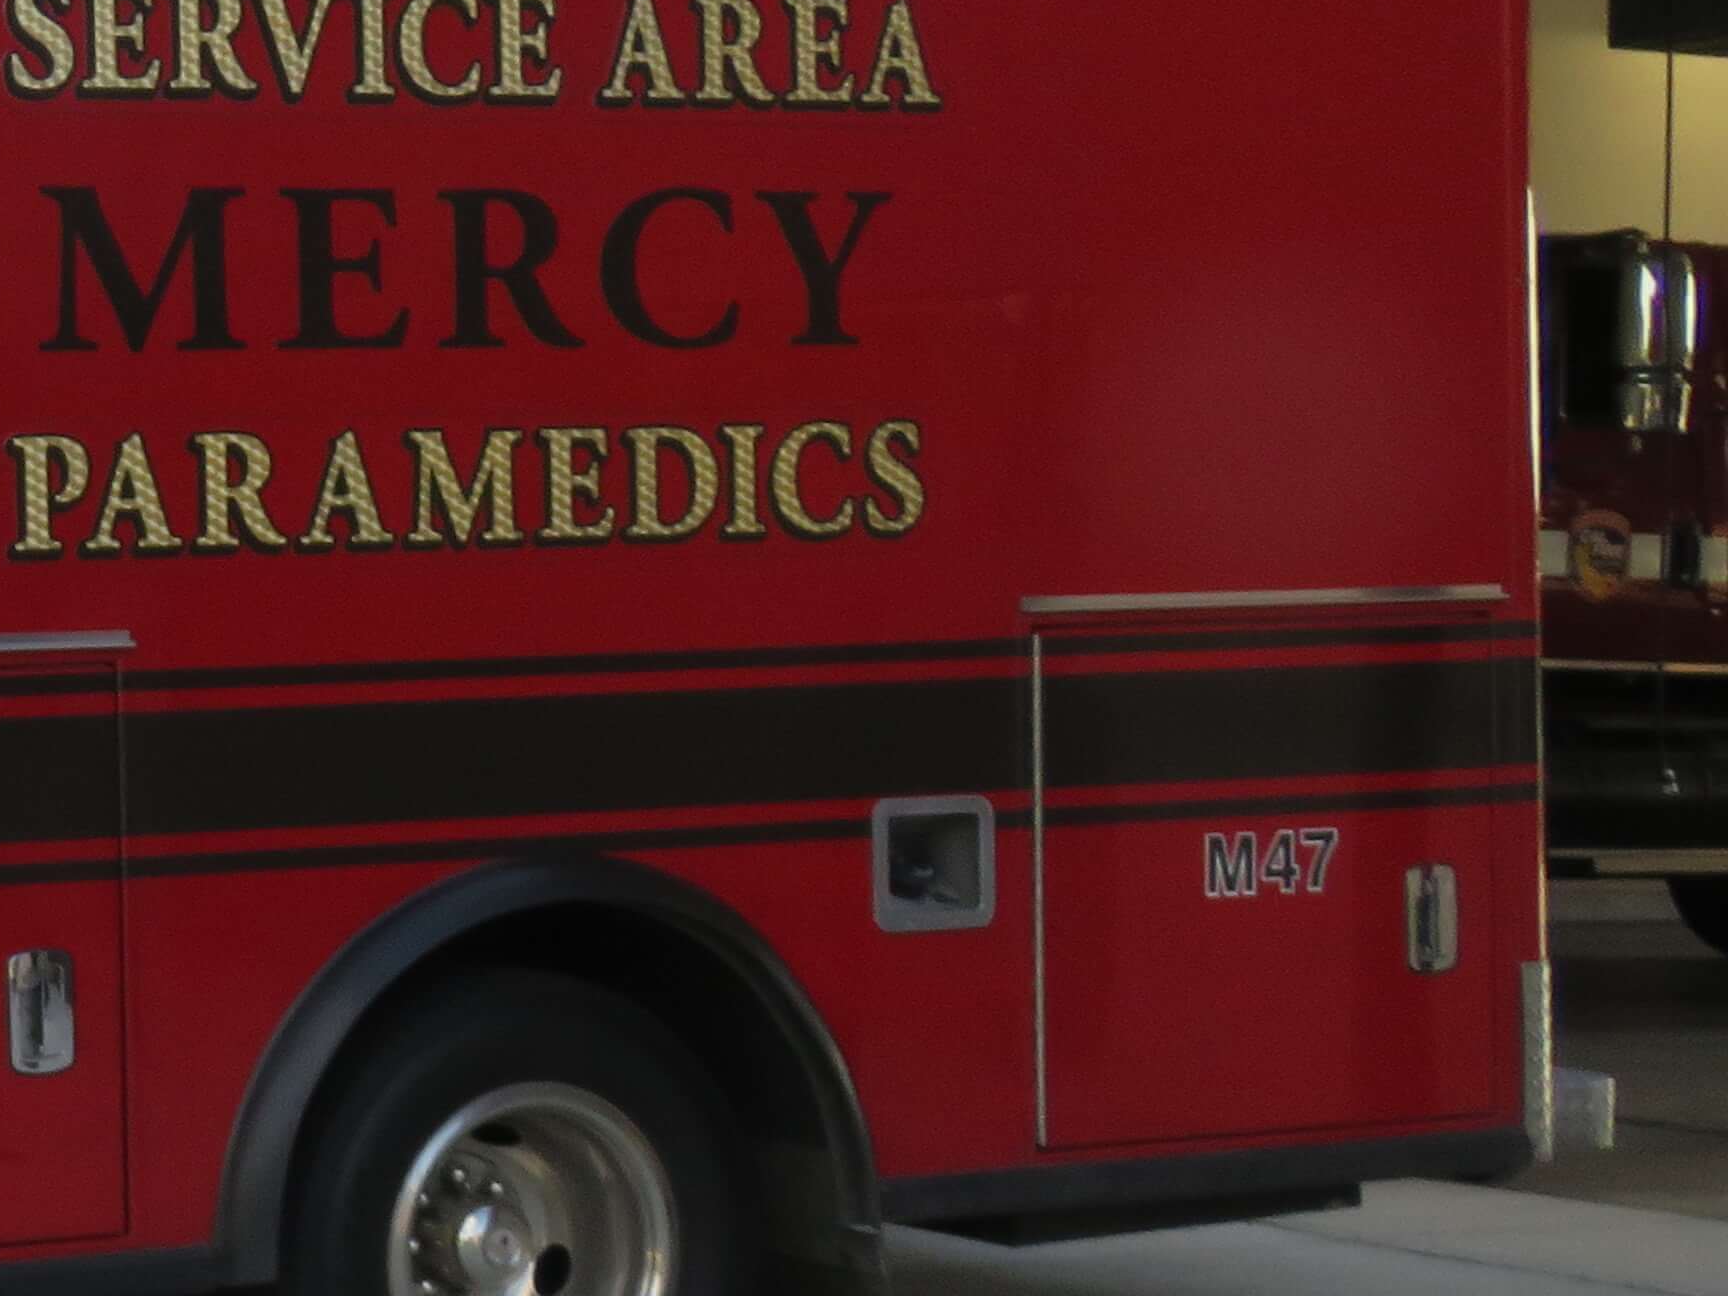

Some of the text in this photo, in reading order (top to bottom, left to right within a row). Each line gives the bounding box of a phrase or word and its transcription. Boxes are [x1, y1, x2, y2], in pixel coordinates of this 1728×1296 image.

[38, 185, 892, 352] MERCY
[8, 420, 925, 558] PARAMEDICS
[1204, 828, 1338, 897] M47
